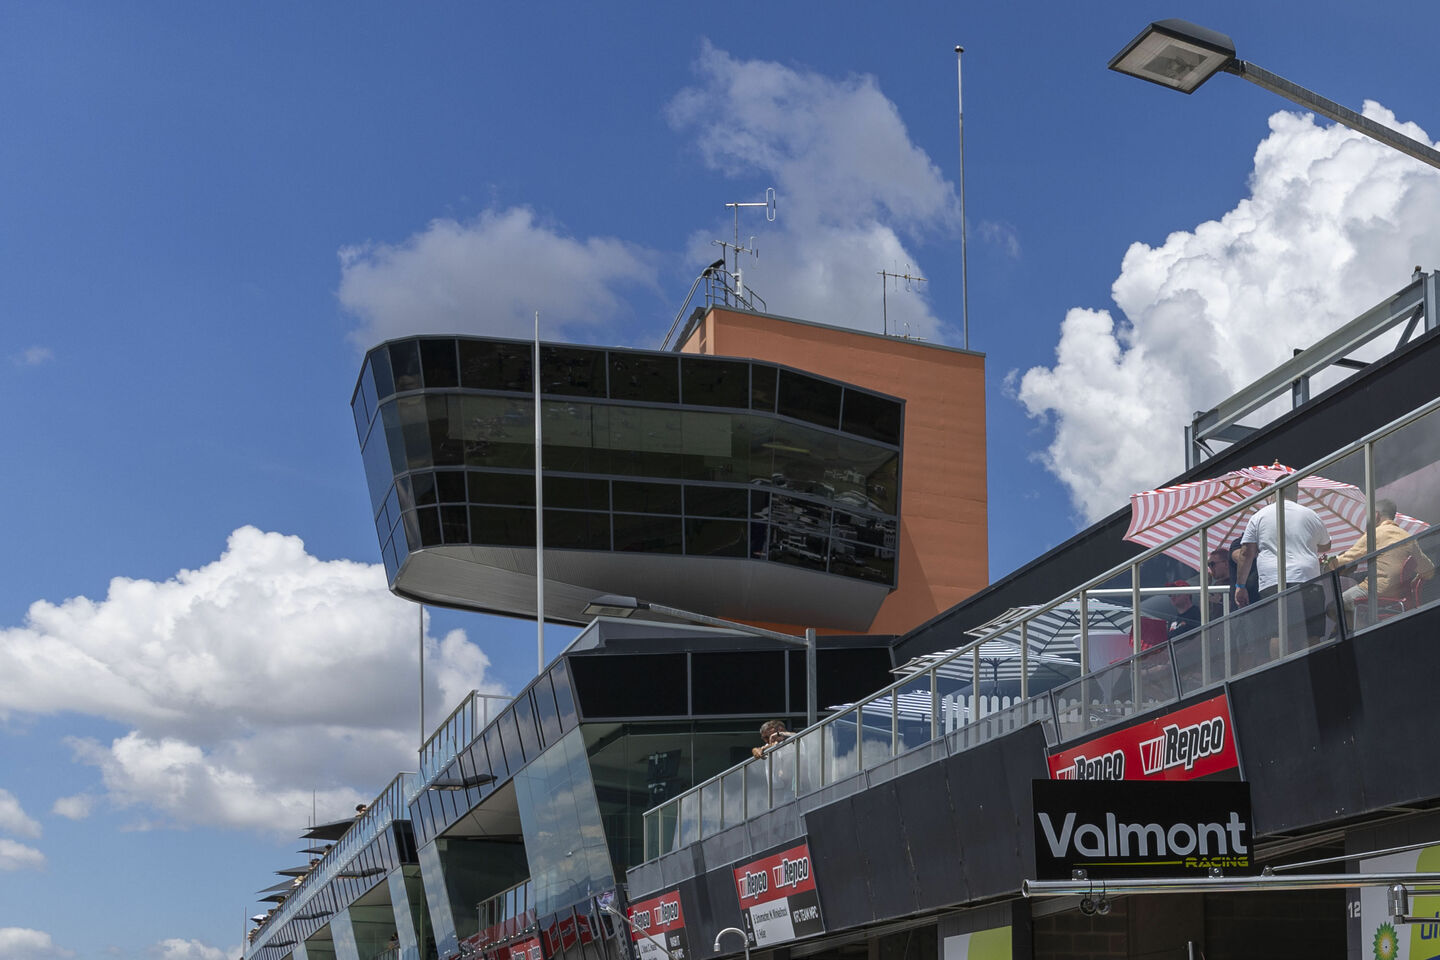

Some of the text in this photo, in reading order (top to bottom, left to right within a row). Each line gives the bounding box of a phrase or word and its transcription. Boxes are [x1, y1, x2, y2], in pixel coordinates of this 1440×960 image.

[1163, 716, 1225, 770] Repco
[1037, 811, 1248, 858] Valmont
[1185, 857, 1249, 868] RACING
